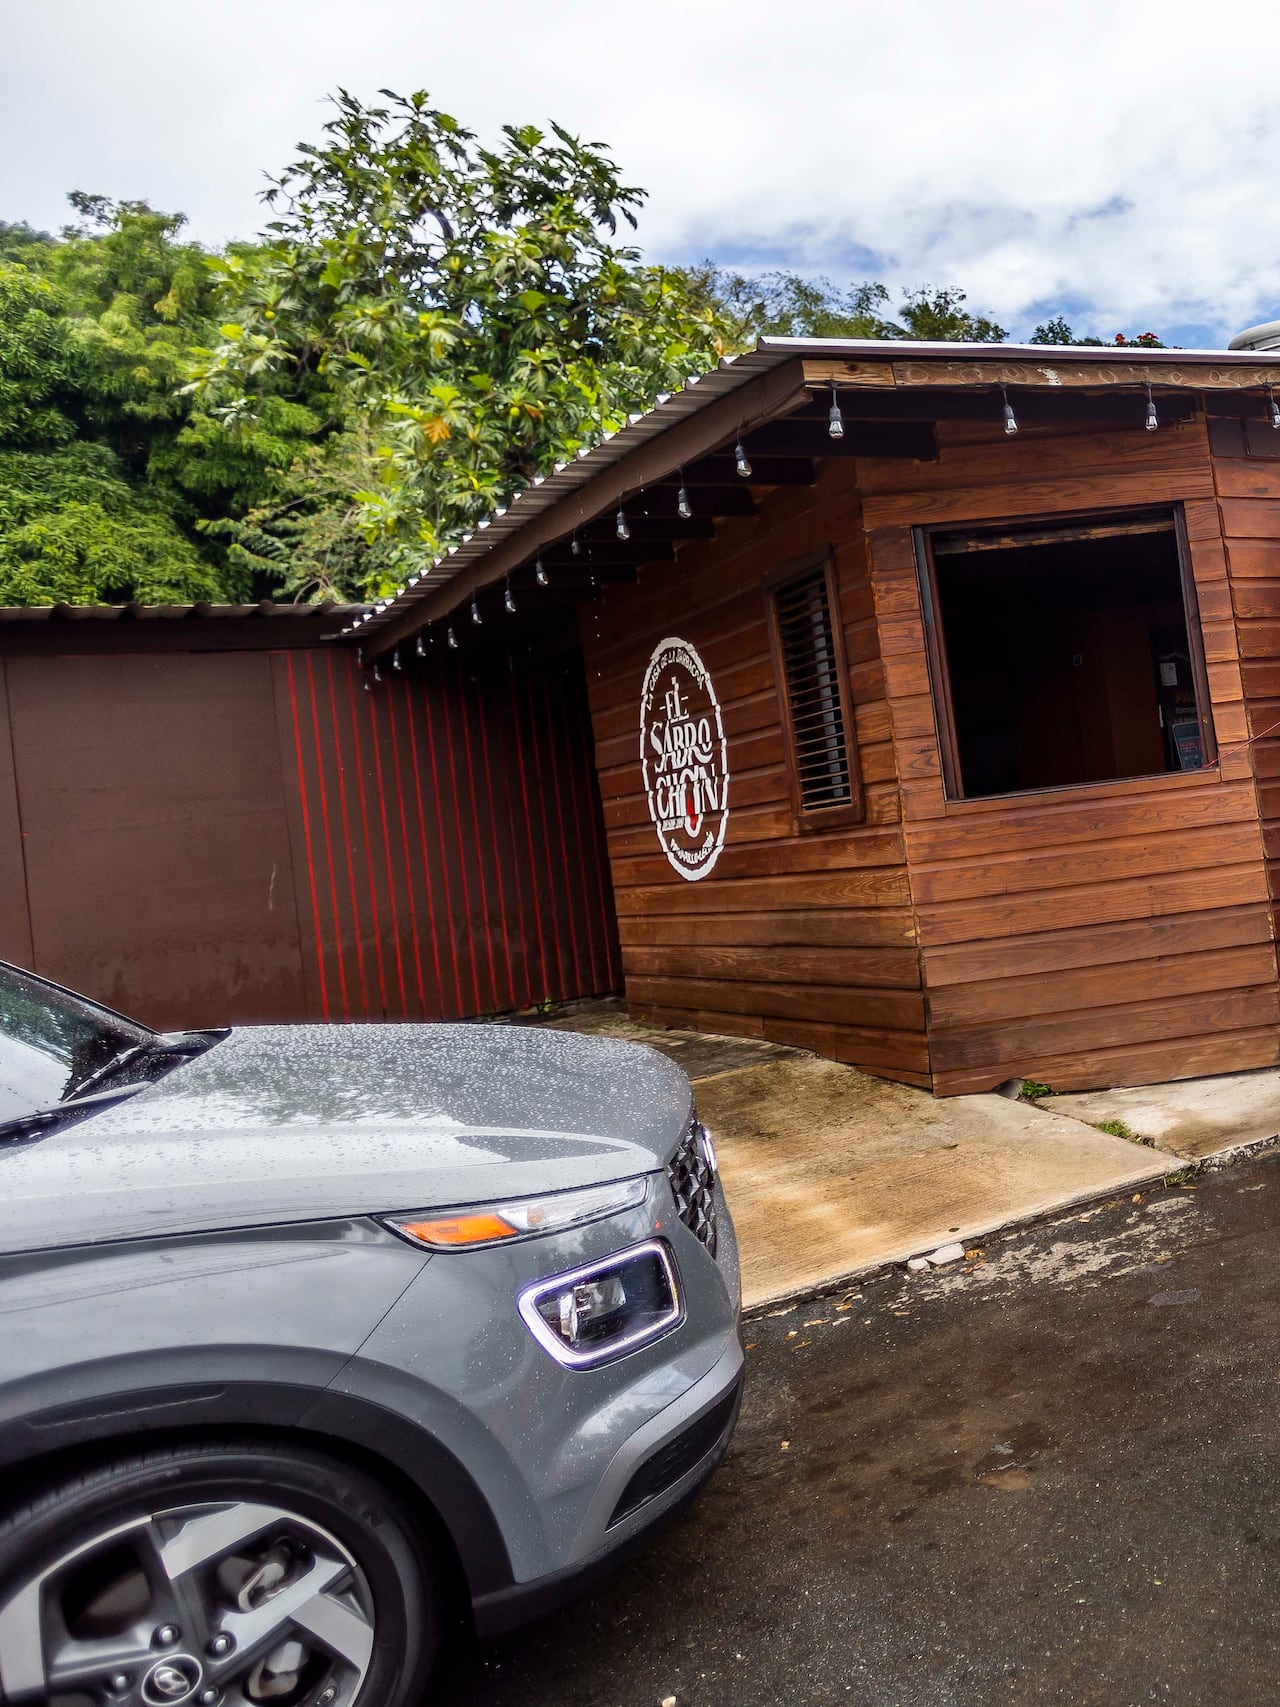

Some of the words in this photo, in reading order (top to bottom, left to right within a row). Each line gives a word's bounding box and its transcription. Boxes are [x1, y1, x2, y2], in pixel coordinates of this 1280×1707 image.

[650, 664, 661, 691] CASA
[668, 650, 676, 663] LA
[665, 676, 689, 723] EL
[651, 718, 713, 773] SABRO
